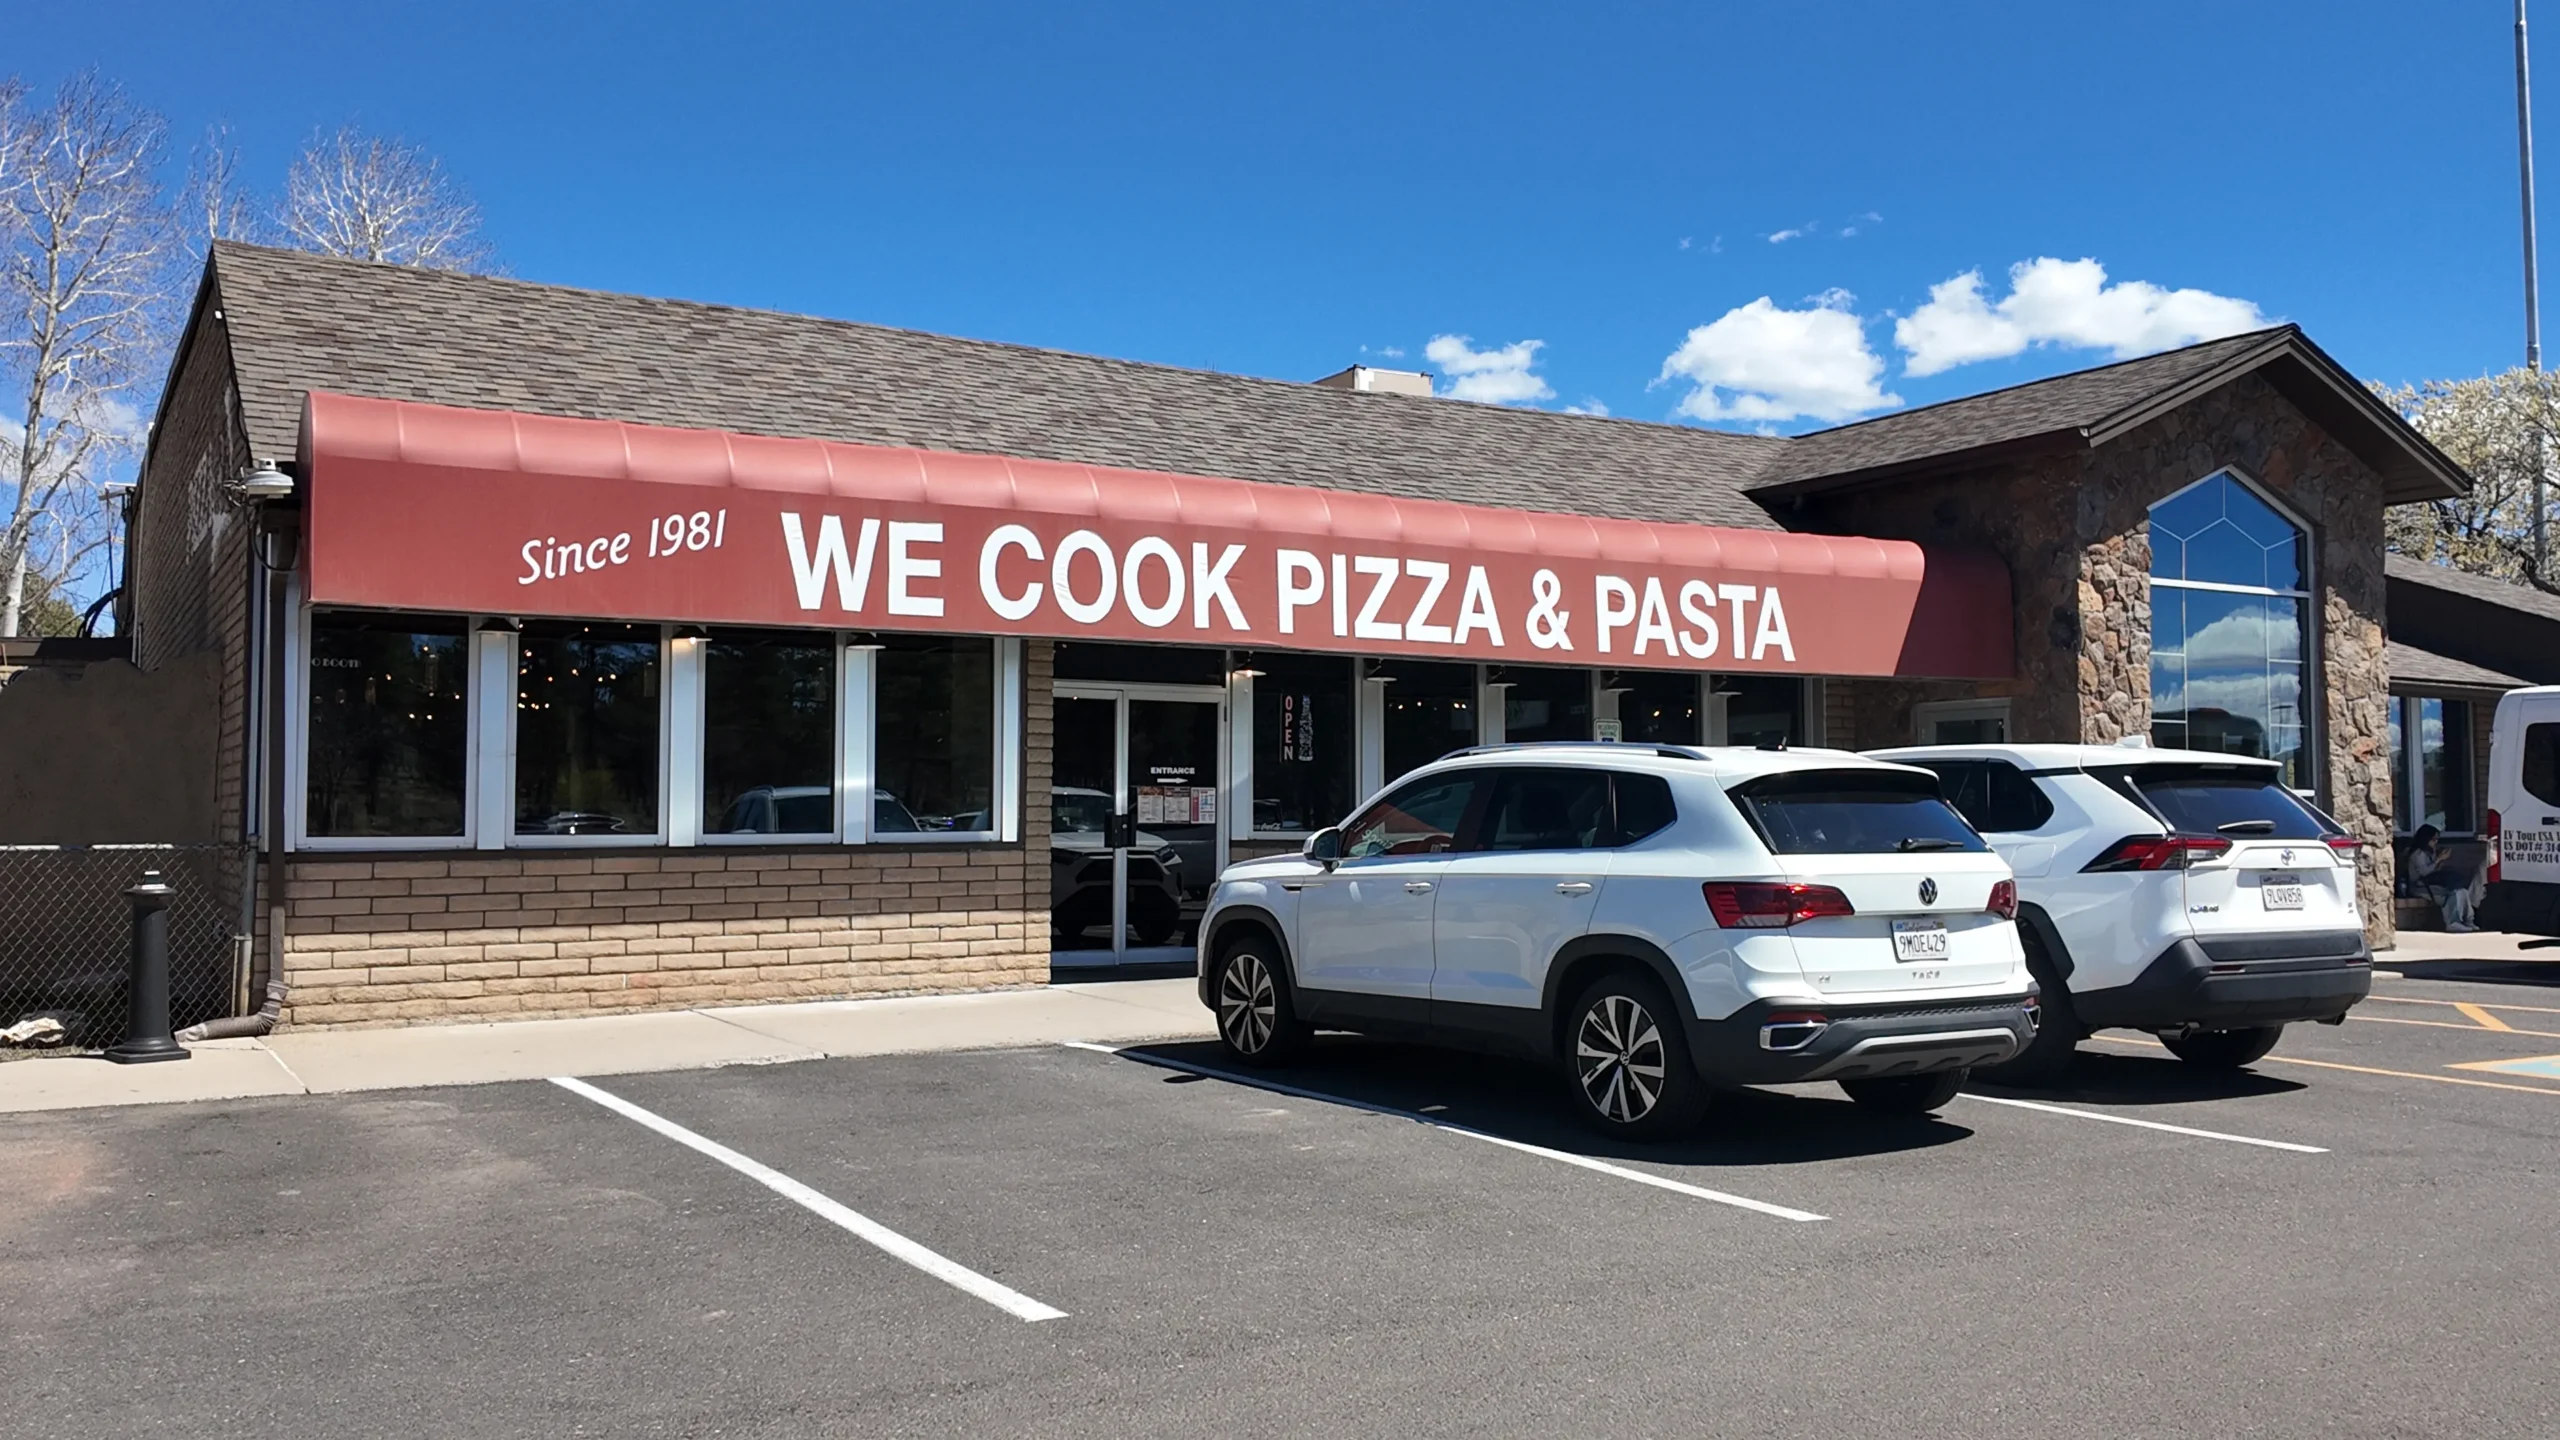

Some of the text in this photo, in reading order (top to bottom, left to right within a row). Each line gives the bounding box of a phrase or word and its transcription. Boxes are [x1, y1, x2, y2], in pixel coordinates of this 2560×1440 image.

[517, 507, 728, 587] Since 1981
[780, 511, 1797, 663] WE COOK PIZZA & PASTA
[1284, 695, 1294, 761] OPEN
[1150, 766, 1196, 775] ENTRANCE
[2504, 841, 2513, 851] US
[2516, 830, 2536, 841] Tour
